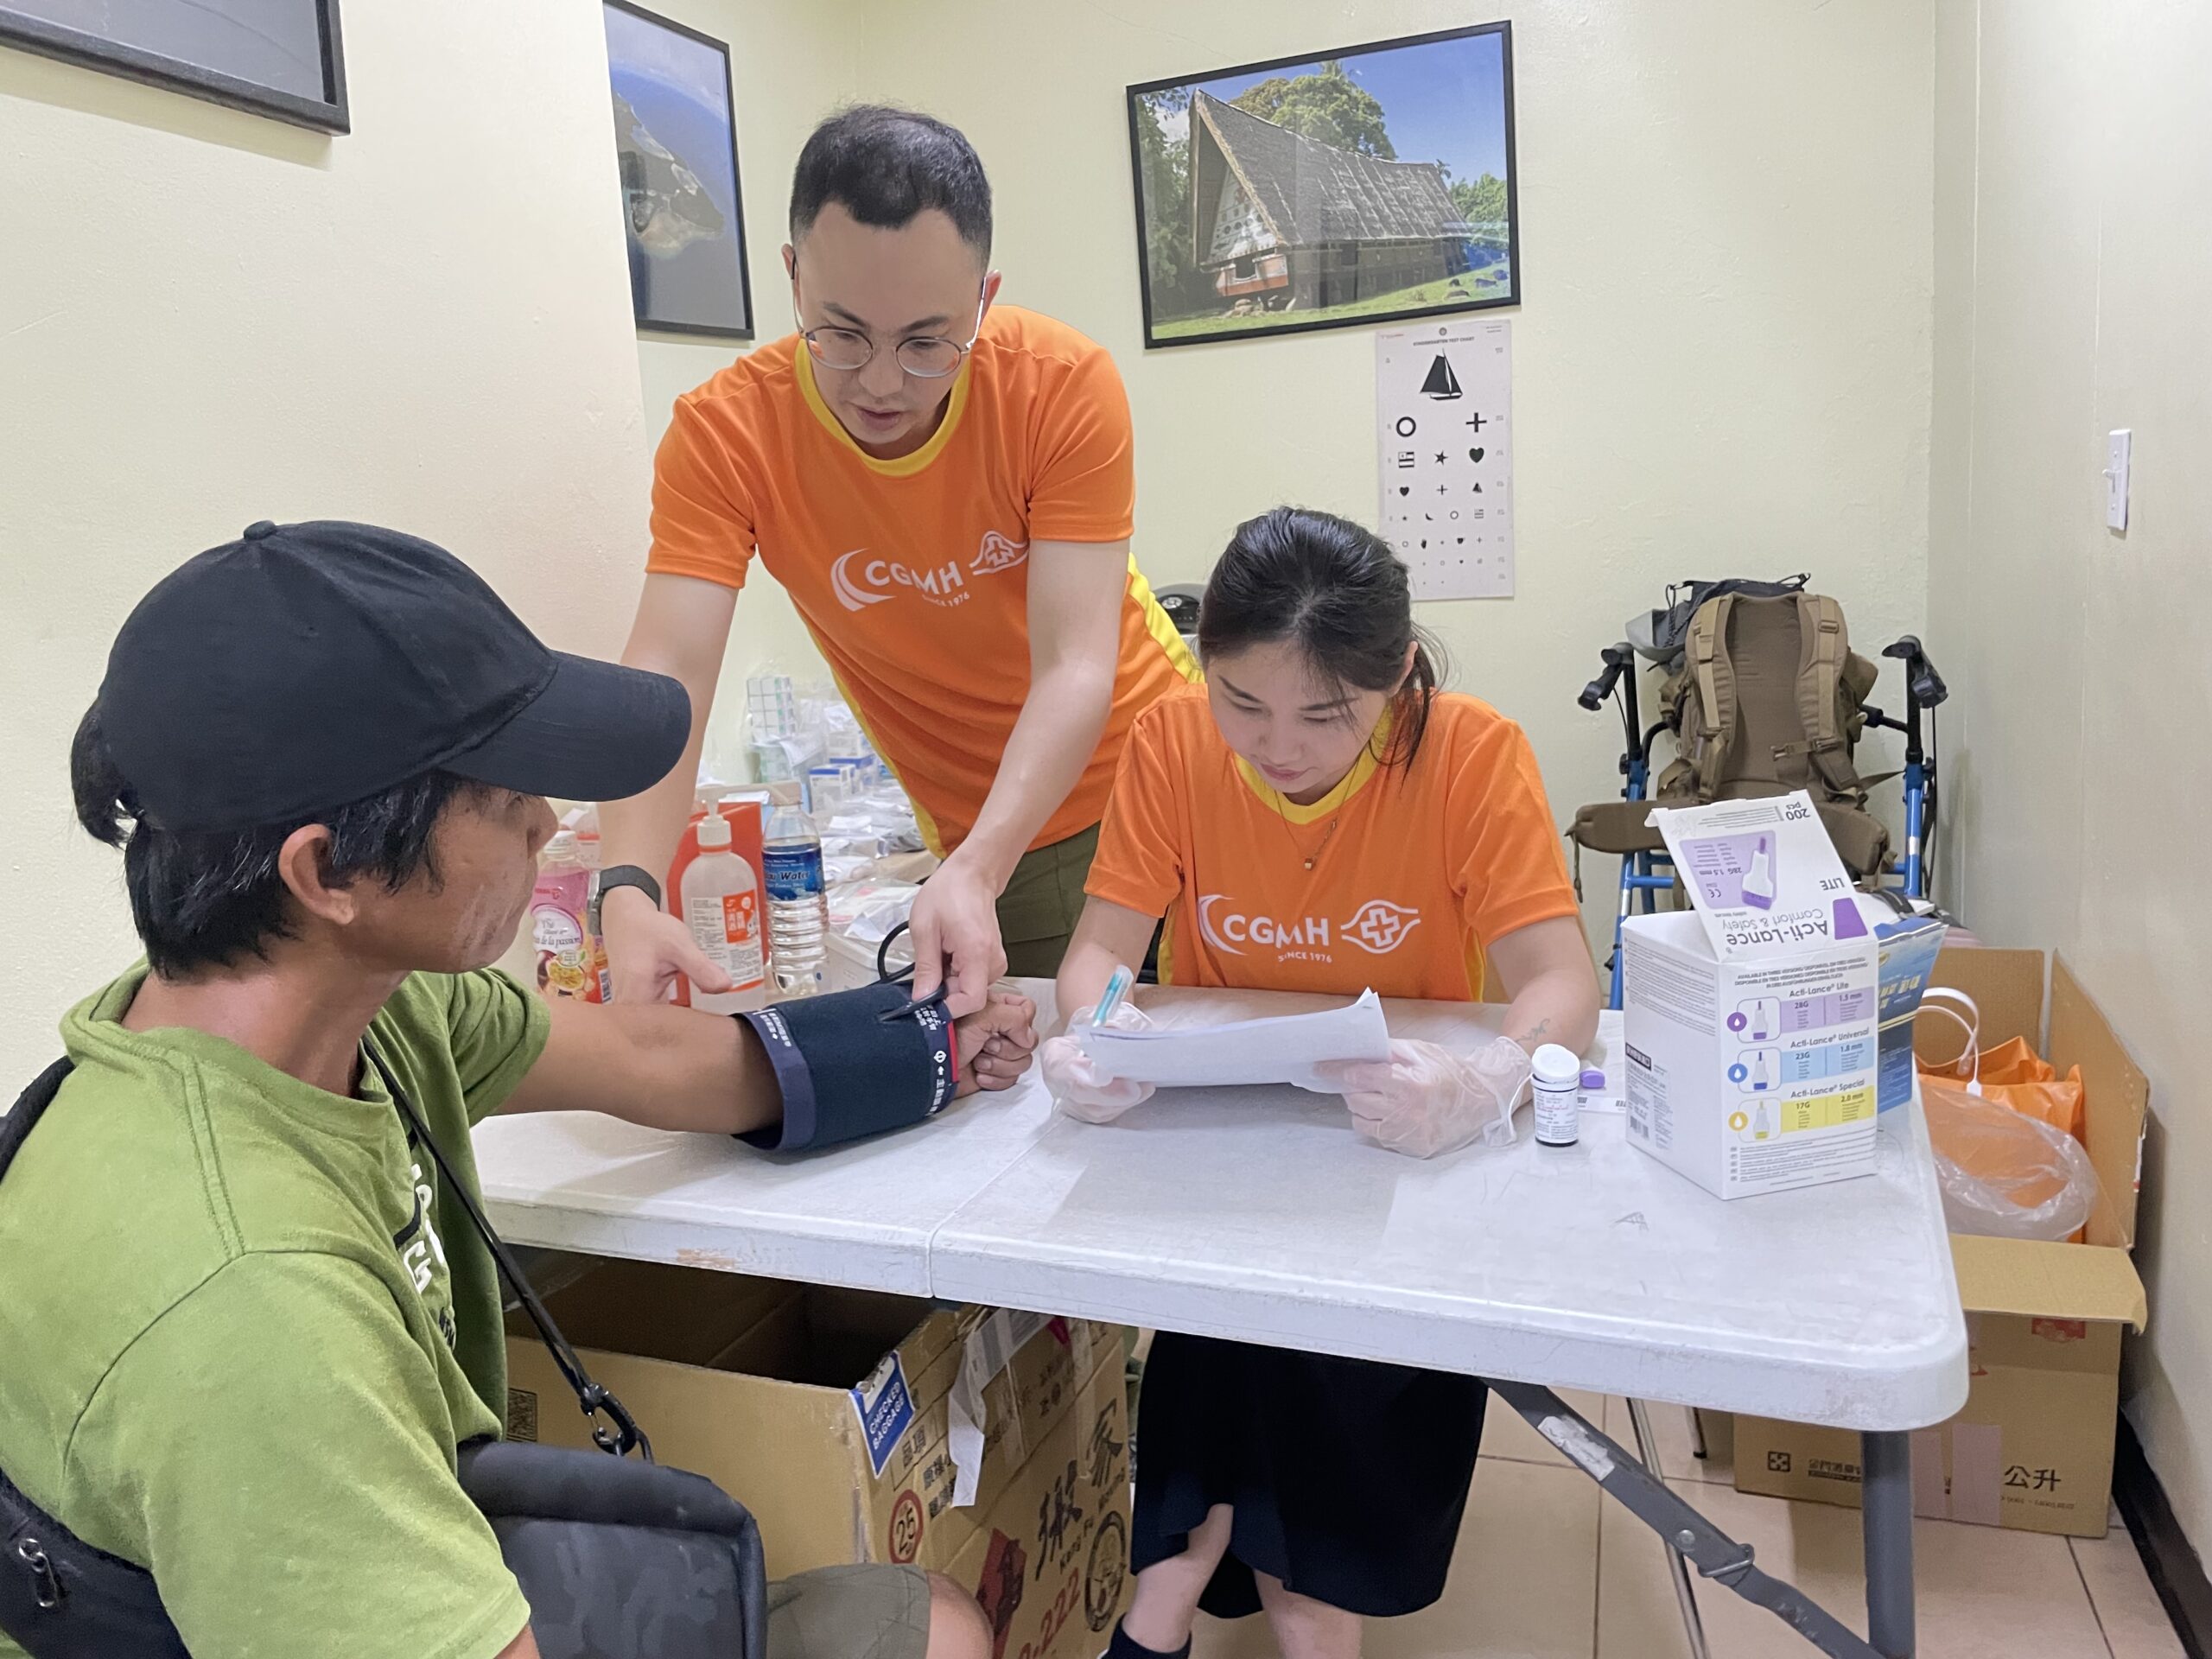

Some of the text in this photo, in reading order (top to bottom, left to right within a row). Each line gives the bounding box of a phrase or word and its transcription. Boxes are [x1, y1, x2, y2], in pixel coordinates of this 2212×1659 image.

[865, 560, 964, 595] CGMH
[1785, 808, 1811, 821] 200
[1820, 877, 1845, 891] LITE
[1722, 917, 1758, 933] Safety
[1772, 908, 1824, 928] Comfort
[1223, 914, 1330, 949] CGMH
[1278, 951, 1332, 963] SINCE 1976
[1795, 1001, 1809, 1009] 28G
[1838, 1027, 1869, 1041] Universal
[1796, 1052, 1810, 1060] 23G
[1840, 1079, 1865, 1092] Special
[1796, 1102, 1810, 1110] 17G
[870, 1382, 900, 1435] CHECKED
[873, 1393, 905, 1450] BAGGAGE
[896, 1506, 915, 1555] 25
